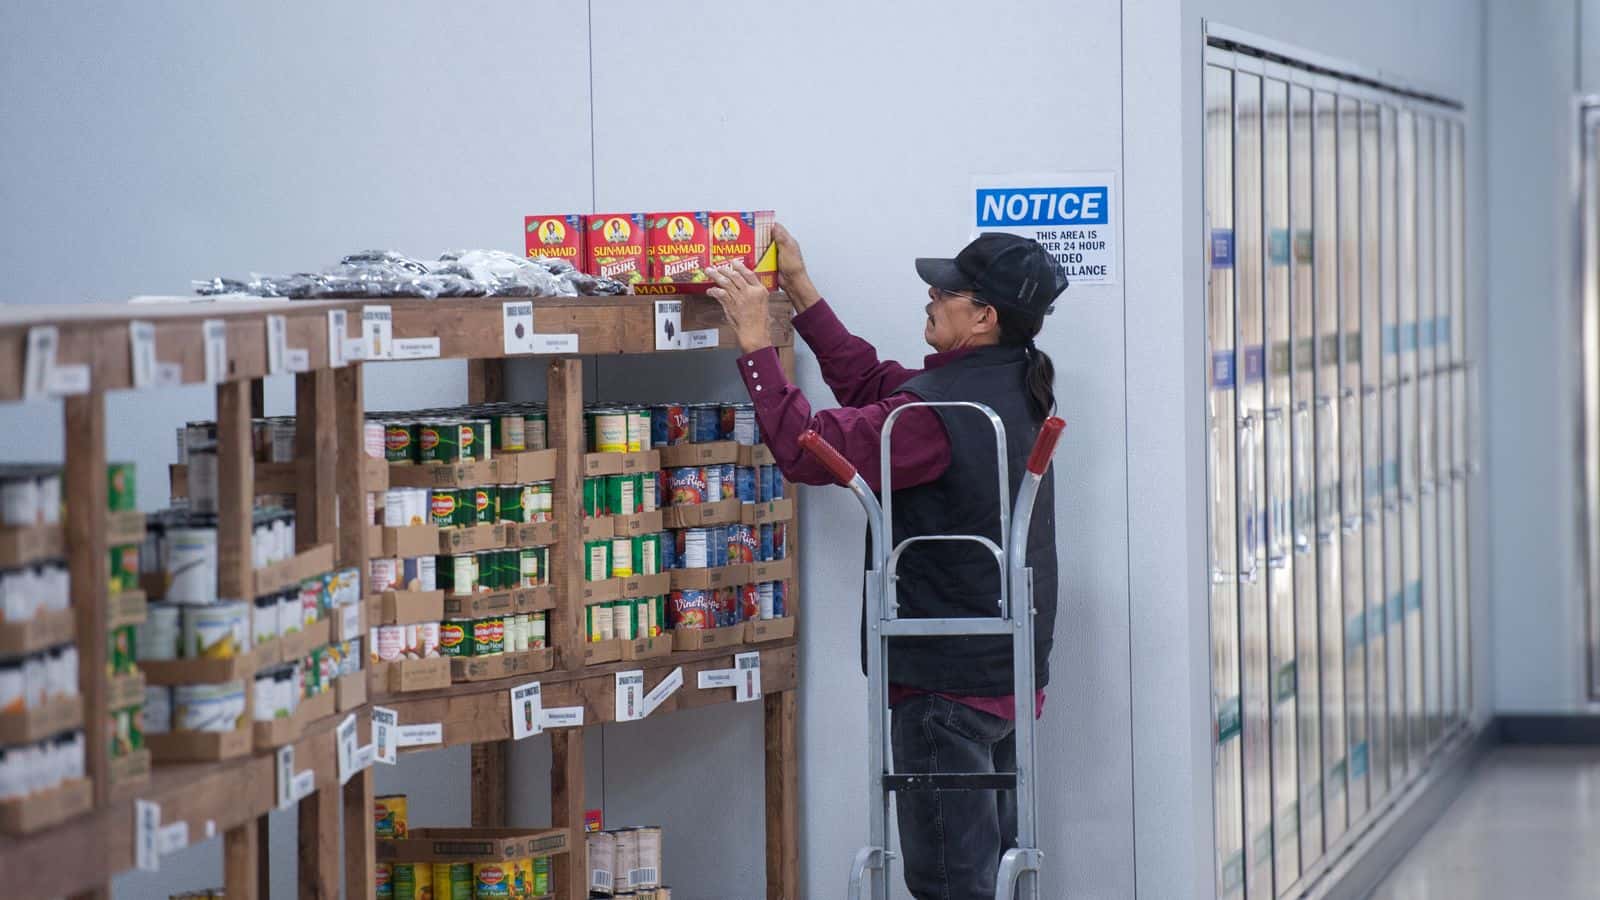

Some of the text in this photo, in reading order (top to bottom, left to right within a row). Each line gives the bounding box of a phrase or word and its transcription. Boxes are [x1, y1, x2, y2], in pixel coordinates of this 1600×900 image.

[982, 192, 1102, 221] NOTICE
[1036, 230, 1097, 240] THIS AREA IS
[1041, 241, 1105, 251] DER 24 HOUR
[1052, 253, 1083, 264] VIDEO
[601, 261, 636, 279] RAISINS
[664, 259, 700, 276] RAISINS
[1064, 265, 1107, 276] ILLANCE
[635, 285, 676, 295] MAID
[674, 414, 689, 427] Vin
[674, 598, 697, 611] Vine
